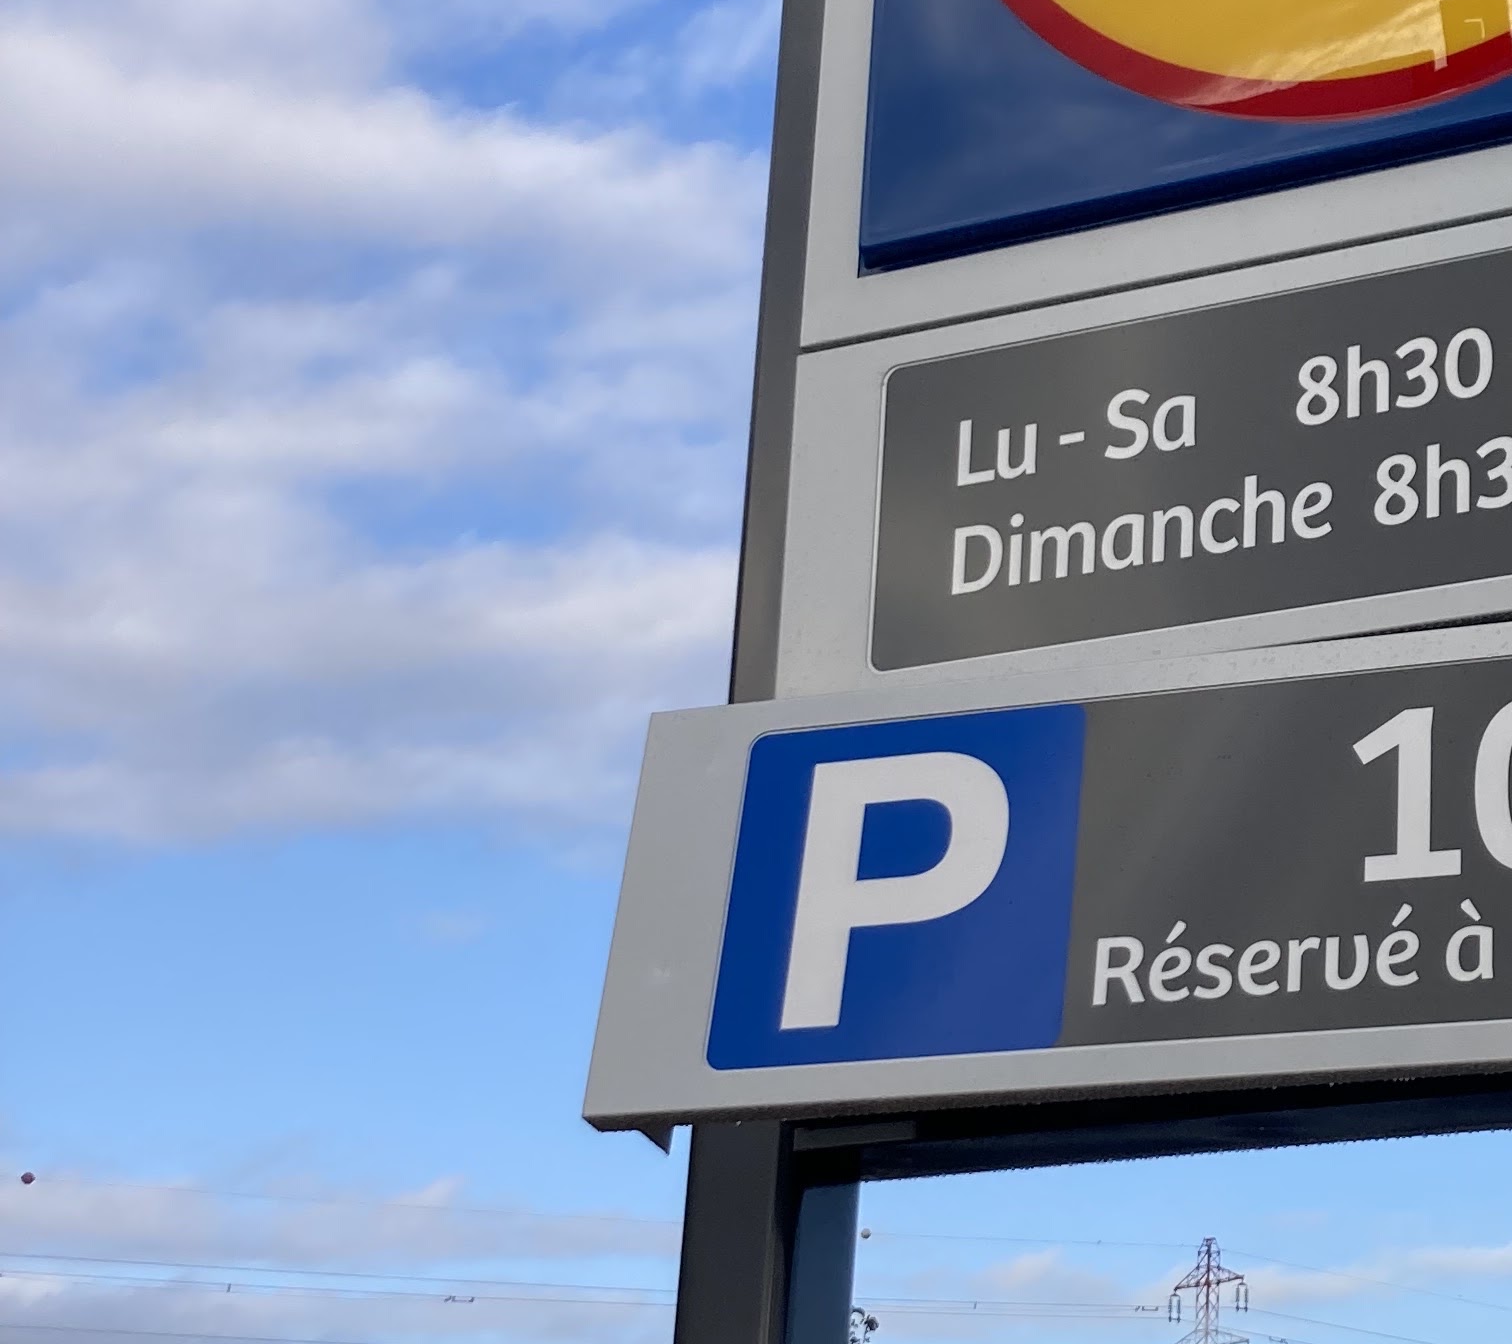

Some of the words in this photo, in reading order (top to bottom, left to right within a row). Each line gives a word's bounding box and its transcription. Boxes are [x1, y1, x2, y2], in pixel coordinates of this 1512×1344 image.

[956, 419, 1038, 487] Lu
[1104, 388, 1196, 460] Sa
[1295, 327, 1493, 426] 8h30
[951, 474, 1333, 596] Dimanche
[780, 751, 1009, 1030] P
[1092, 903, 1420, 1006] Réservé
[1445, 898, 1494, 982] à
